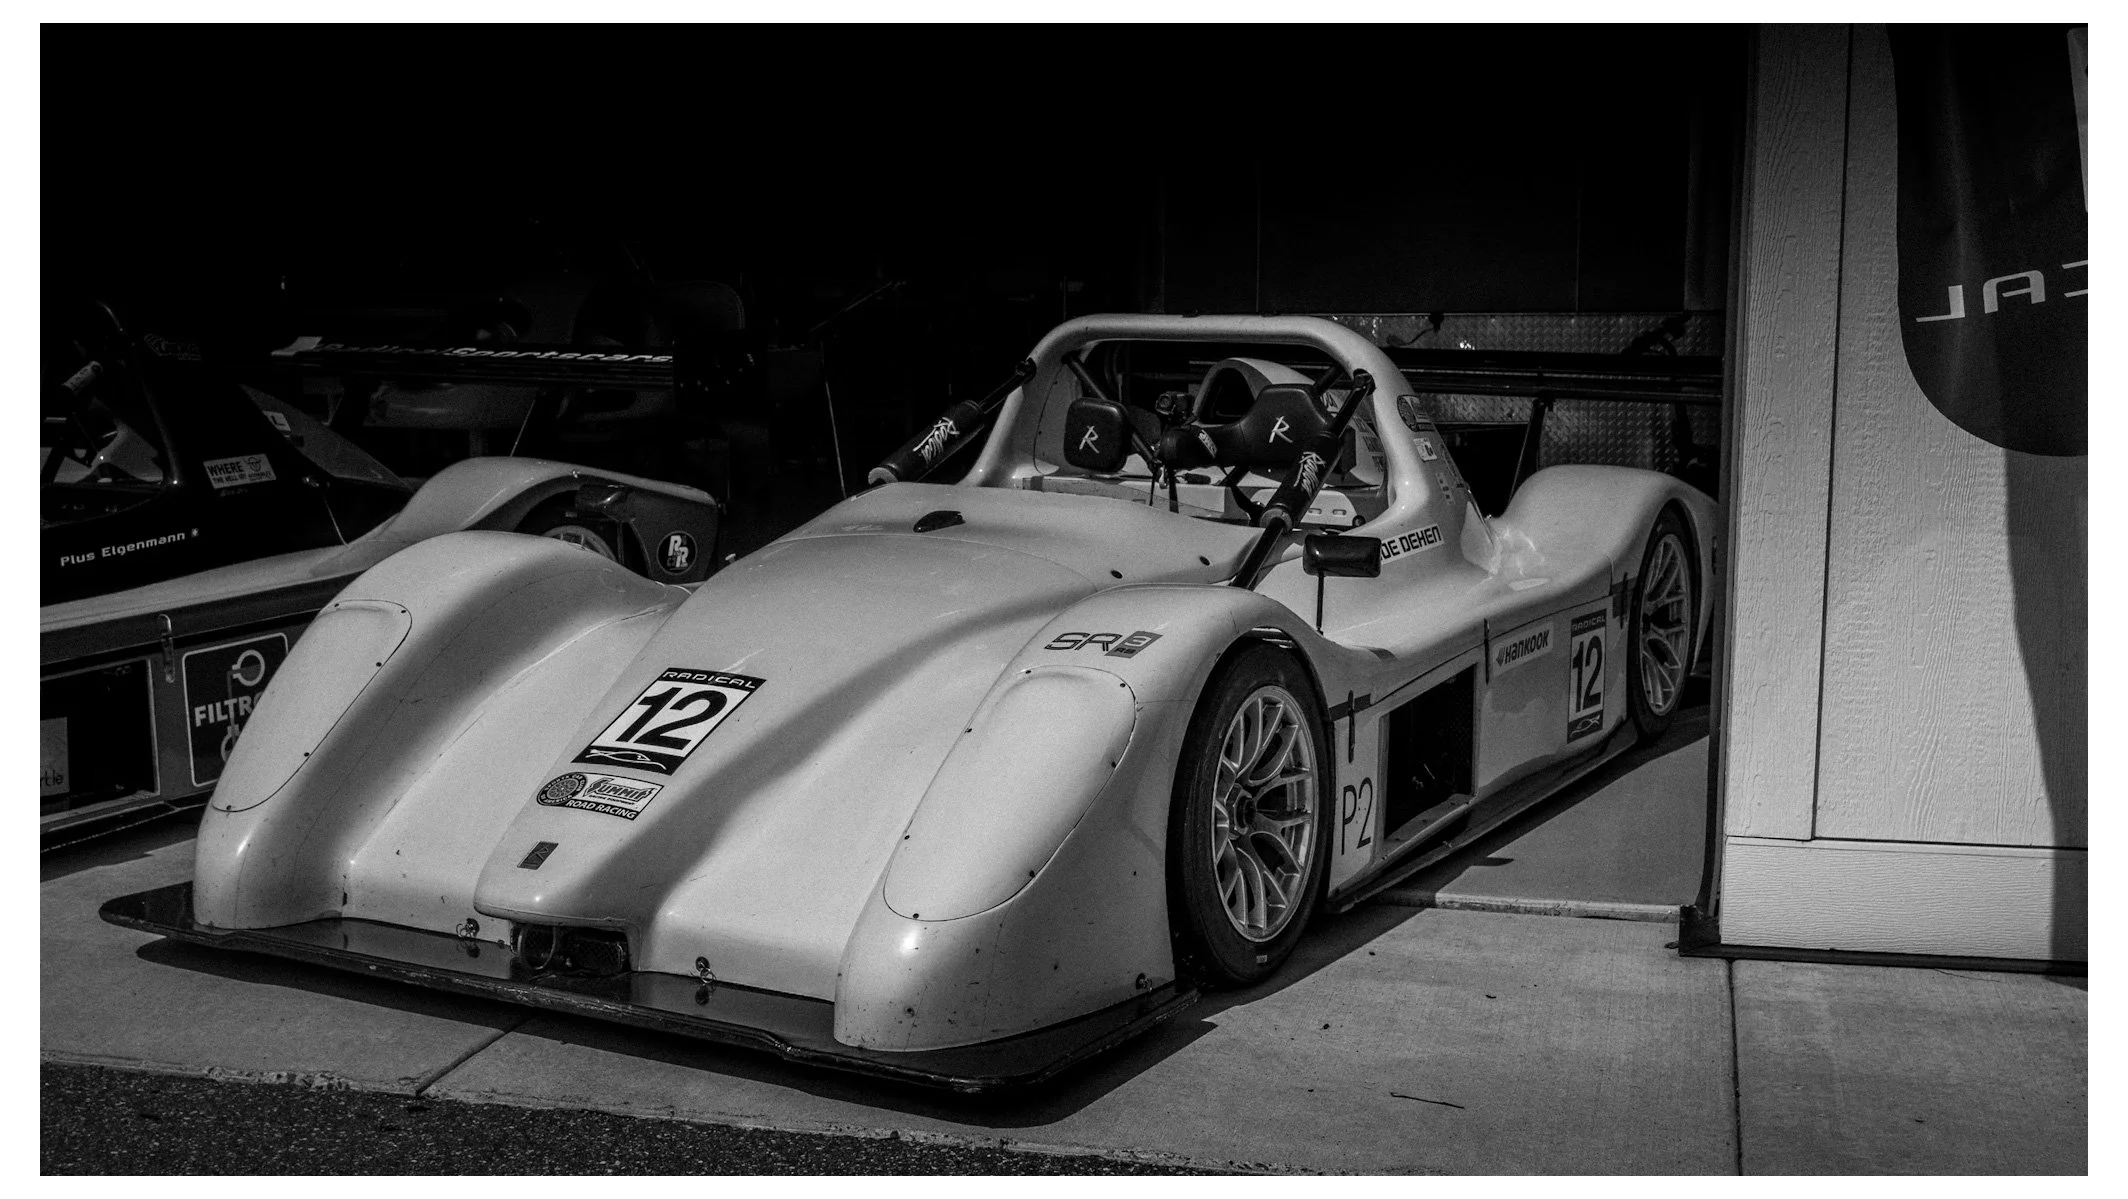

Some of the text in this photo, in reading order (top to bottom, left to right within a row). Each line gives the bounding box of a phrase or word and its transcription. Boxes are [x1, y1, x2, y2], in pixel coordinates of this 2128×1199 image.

[1079, 425, 1100, 454] R
[1268, 415, 1294, 443] R
[207, 461, 244, 477] WHERE
[1380, 525, 1442, 561] DE DEHEN
[661, 670, 757, 690] RADICAL
[1572, 635, 1603, 714] 12
[615, 687, 728, 750] 12
[565, 799, 638, 819] ROAD RACING
[1341, 777, 1373, 855] P2
